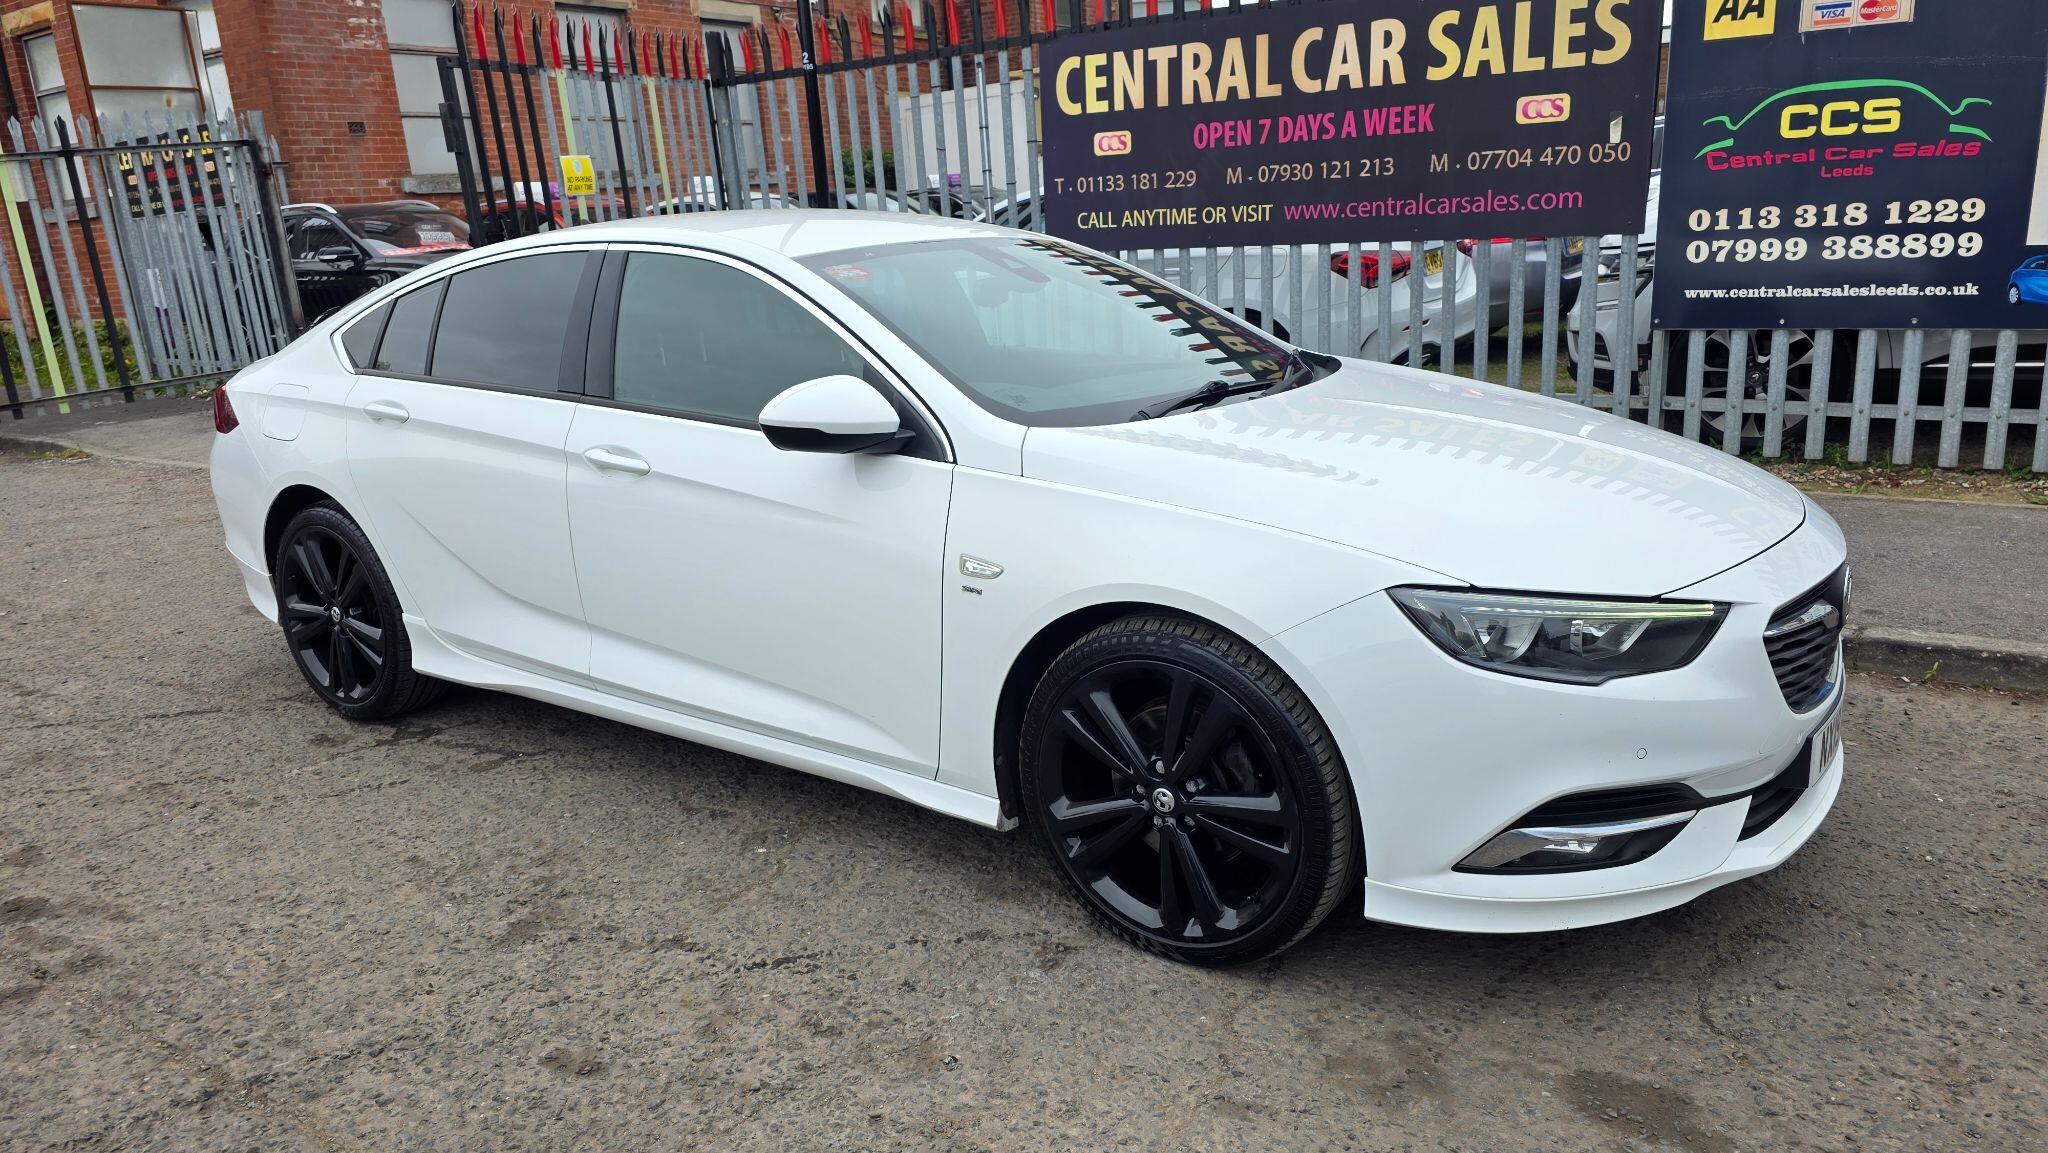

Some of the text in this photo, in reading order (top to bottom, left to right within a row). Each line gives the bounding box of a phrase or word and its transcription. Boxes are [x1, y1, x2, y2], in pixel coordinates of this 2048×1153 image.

[1711, 0, 1765, 24] AA
[1820, 8, 1846, 20] VISA
[1860, 3, 1898, 15] MasterCard
[1055, 0, 1632, 117] CENTRAL CAR SALES
[1521, 97, 1565, 120] CCS
[1779, 97, 1902, 140] CCS
[1193, 103, 1436, 150] OPEN 7 DAYS A WEEK
[1097, 134, 1129, 153] CCS
[1706, 139, 1982, 172] Central Car Sales
[566, 176, 575, 184] NO
[1076, 174, 1124, 193] 01133
[1130, 172, 1158, 190] 181
[1164, 170, 1197, 188] 229
[1258, 162, 1314, 183] 07930
[1320, 160, 1353, 180] 121
[1359, 157, 1396, 177] 213
[1467, 148, 1533, 171] 07704
[1539, 145, 1582, 166] 470
[1588, 141, 1632, 164] 050
[1820, 164, 1874, 178] Leeds
[1077, 189, 1583, 230] CALL ANYTIME OR VISIT www.centralcarsales.com
[1688, 198, 1987, 232] 0113 318 1229
[1685, 232, 1984, 264] 07999 388899
[1684, 282, 1980, 299] www.centralcarsalesleeds.co.uk
